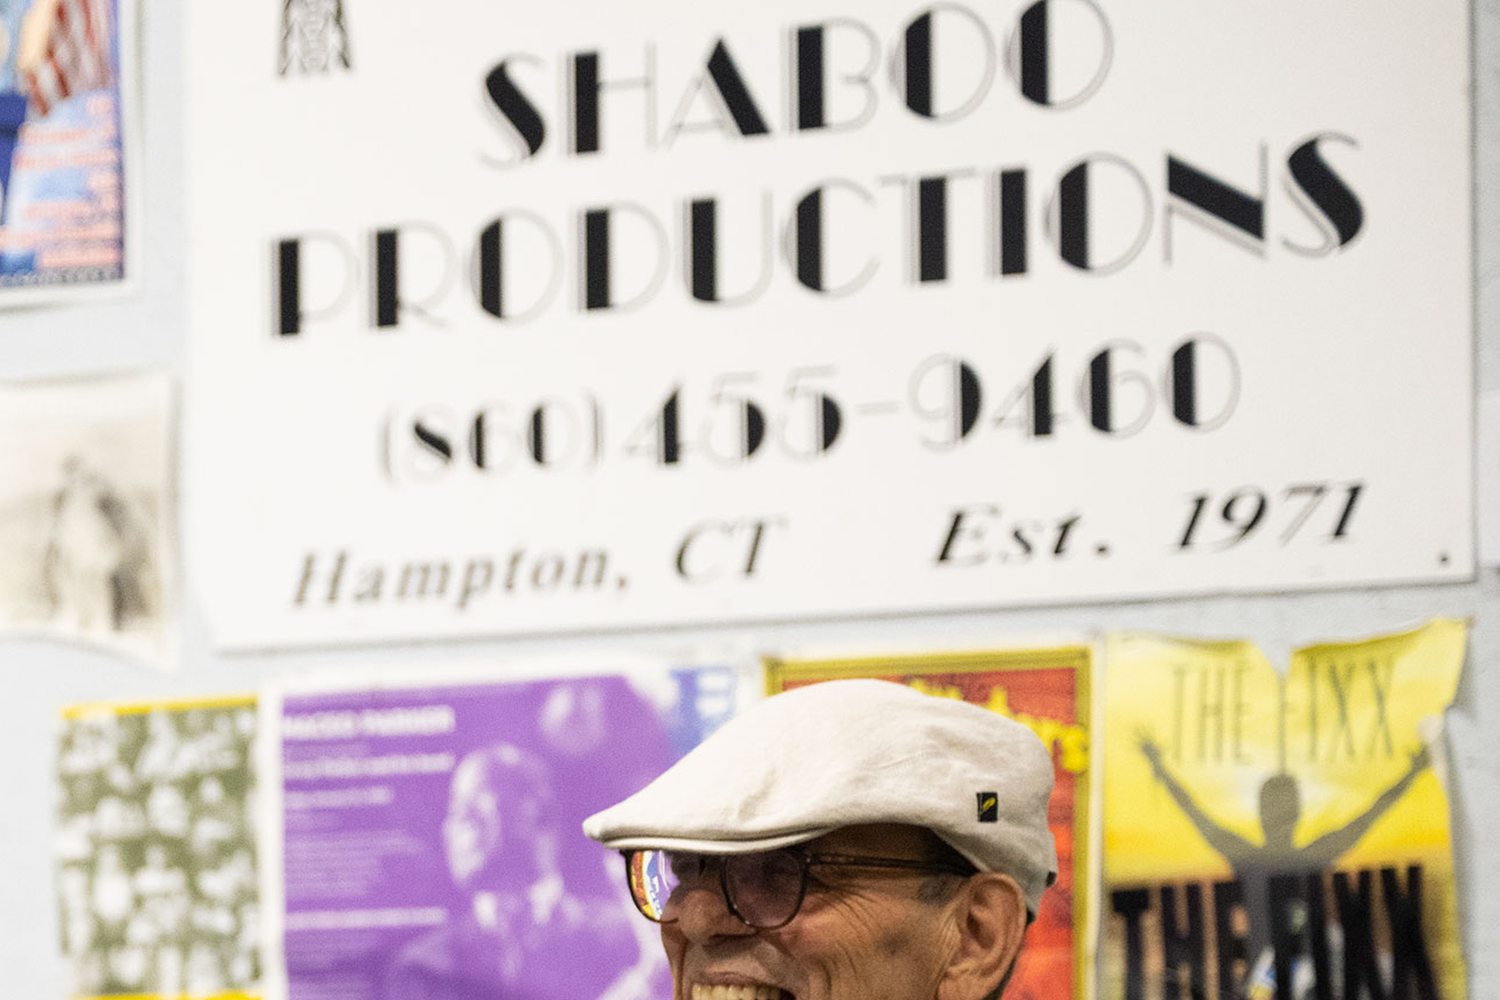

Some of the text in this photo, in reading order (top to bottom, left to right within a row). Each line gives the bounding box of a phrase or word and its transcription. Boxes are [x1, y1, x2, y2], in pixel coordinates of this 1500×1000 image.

[475, 0, 1115, 170] SHABOO
[268, 130, 1366, 338] PRODUCTIONS
[293, 477, 1368, 612] Hampton, CT Est. 1971
[1168, 658, 1252, 766] THE
